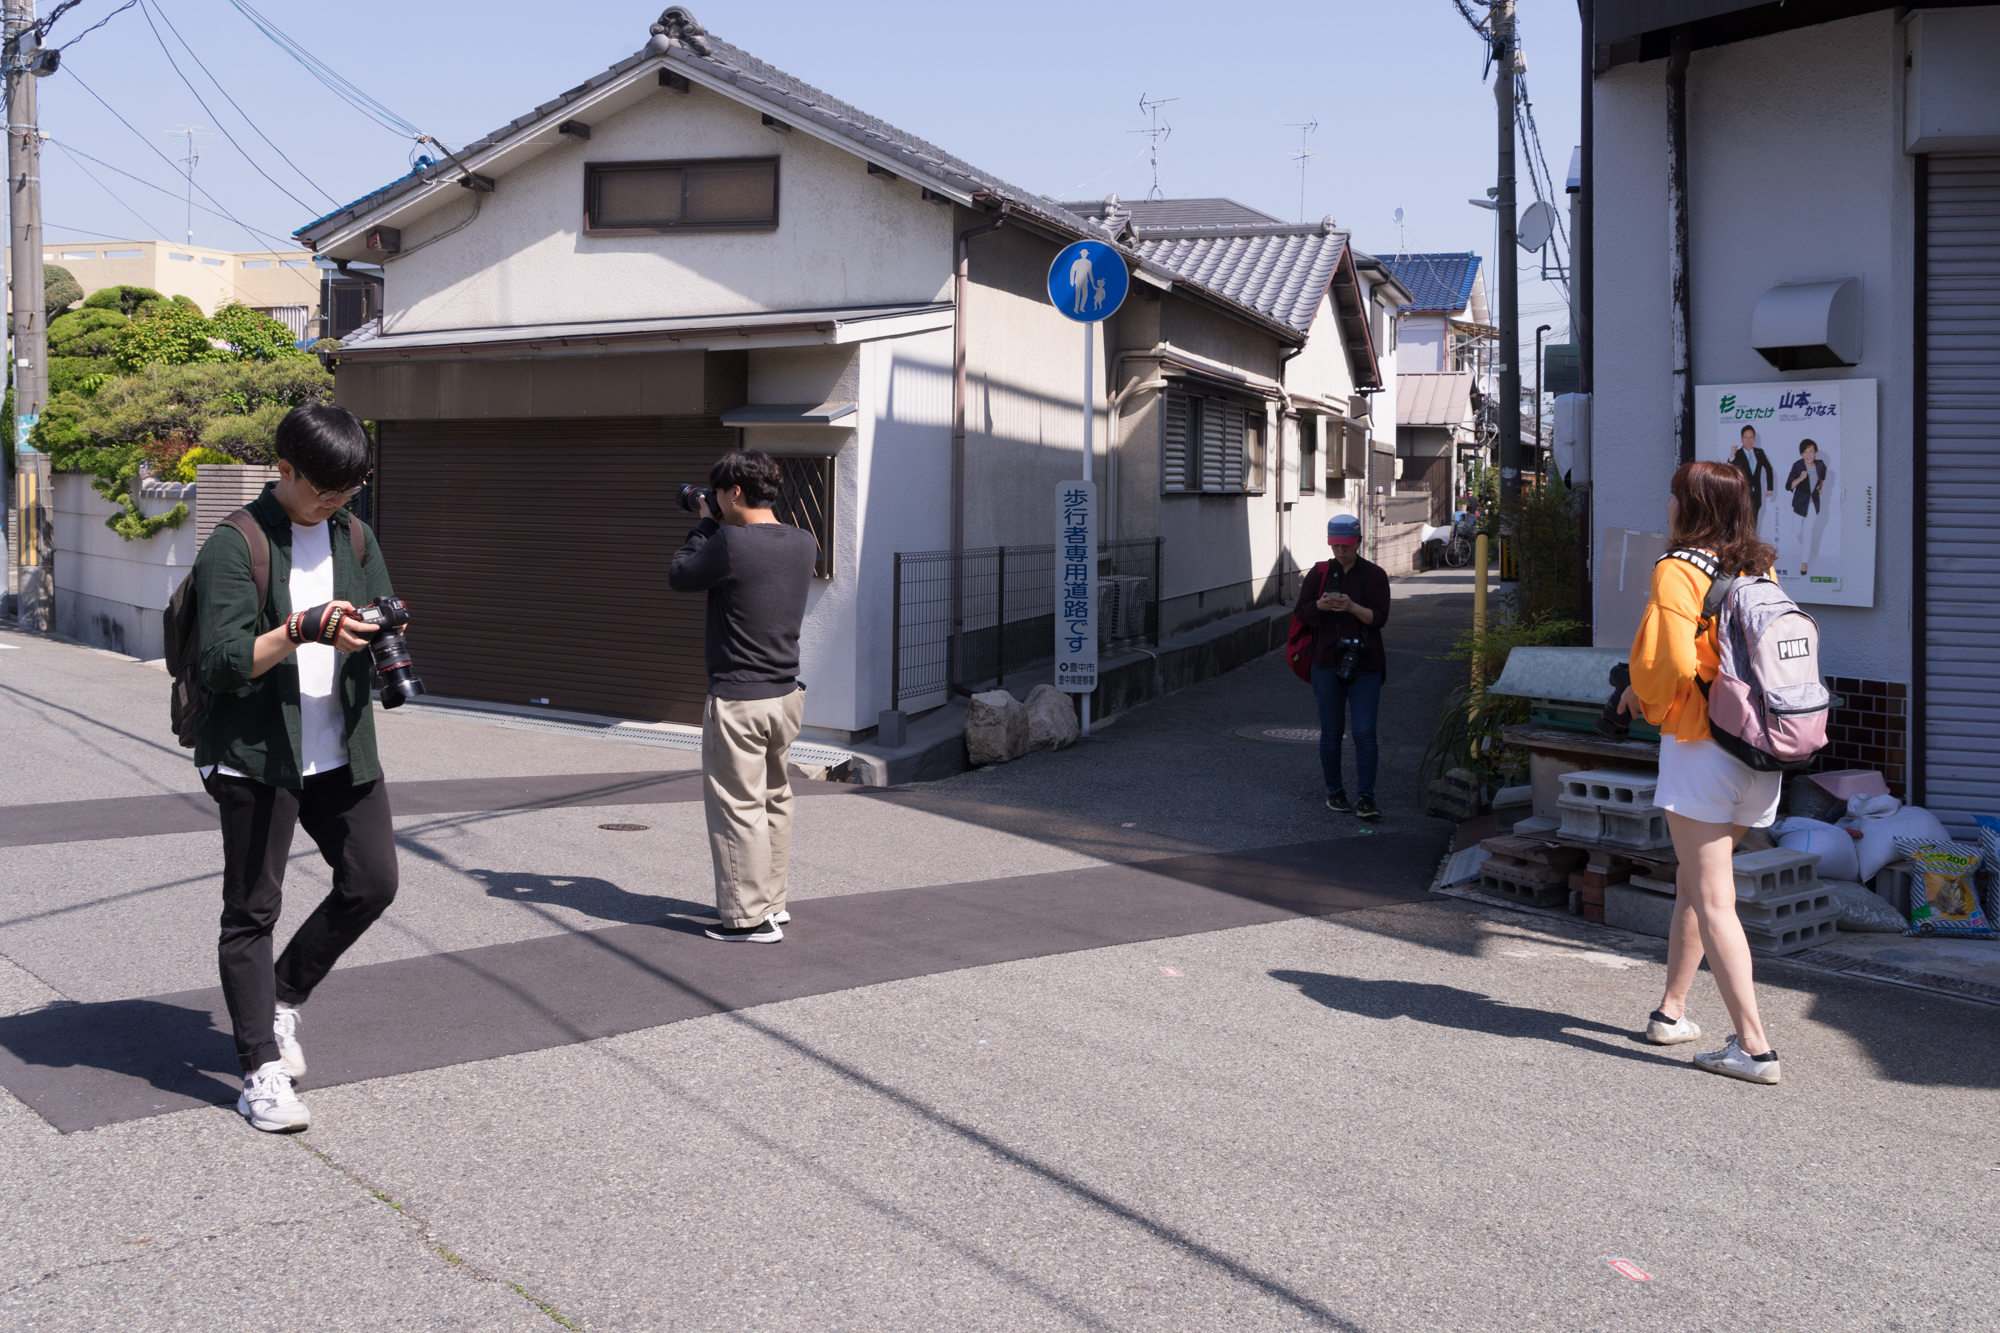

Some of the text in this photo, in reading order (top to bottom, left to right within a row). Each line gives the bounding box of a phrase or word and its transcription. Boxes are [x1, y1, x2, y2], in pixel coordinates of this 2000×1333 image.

[1063, 488, 1089, 653] 歩行者専用道路です
[324, 607, 344, 639] Canon
[1779, 639, 1809, 659] PINK
[1069, 662, 1095, 673] 豊中市
[1058, 675, 1095, 685] 豊中南警察署
[1946, 854, 1968, 866] 200
